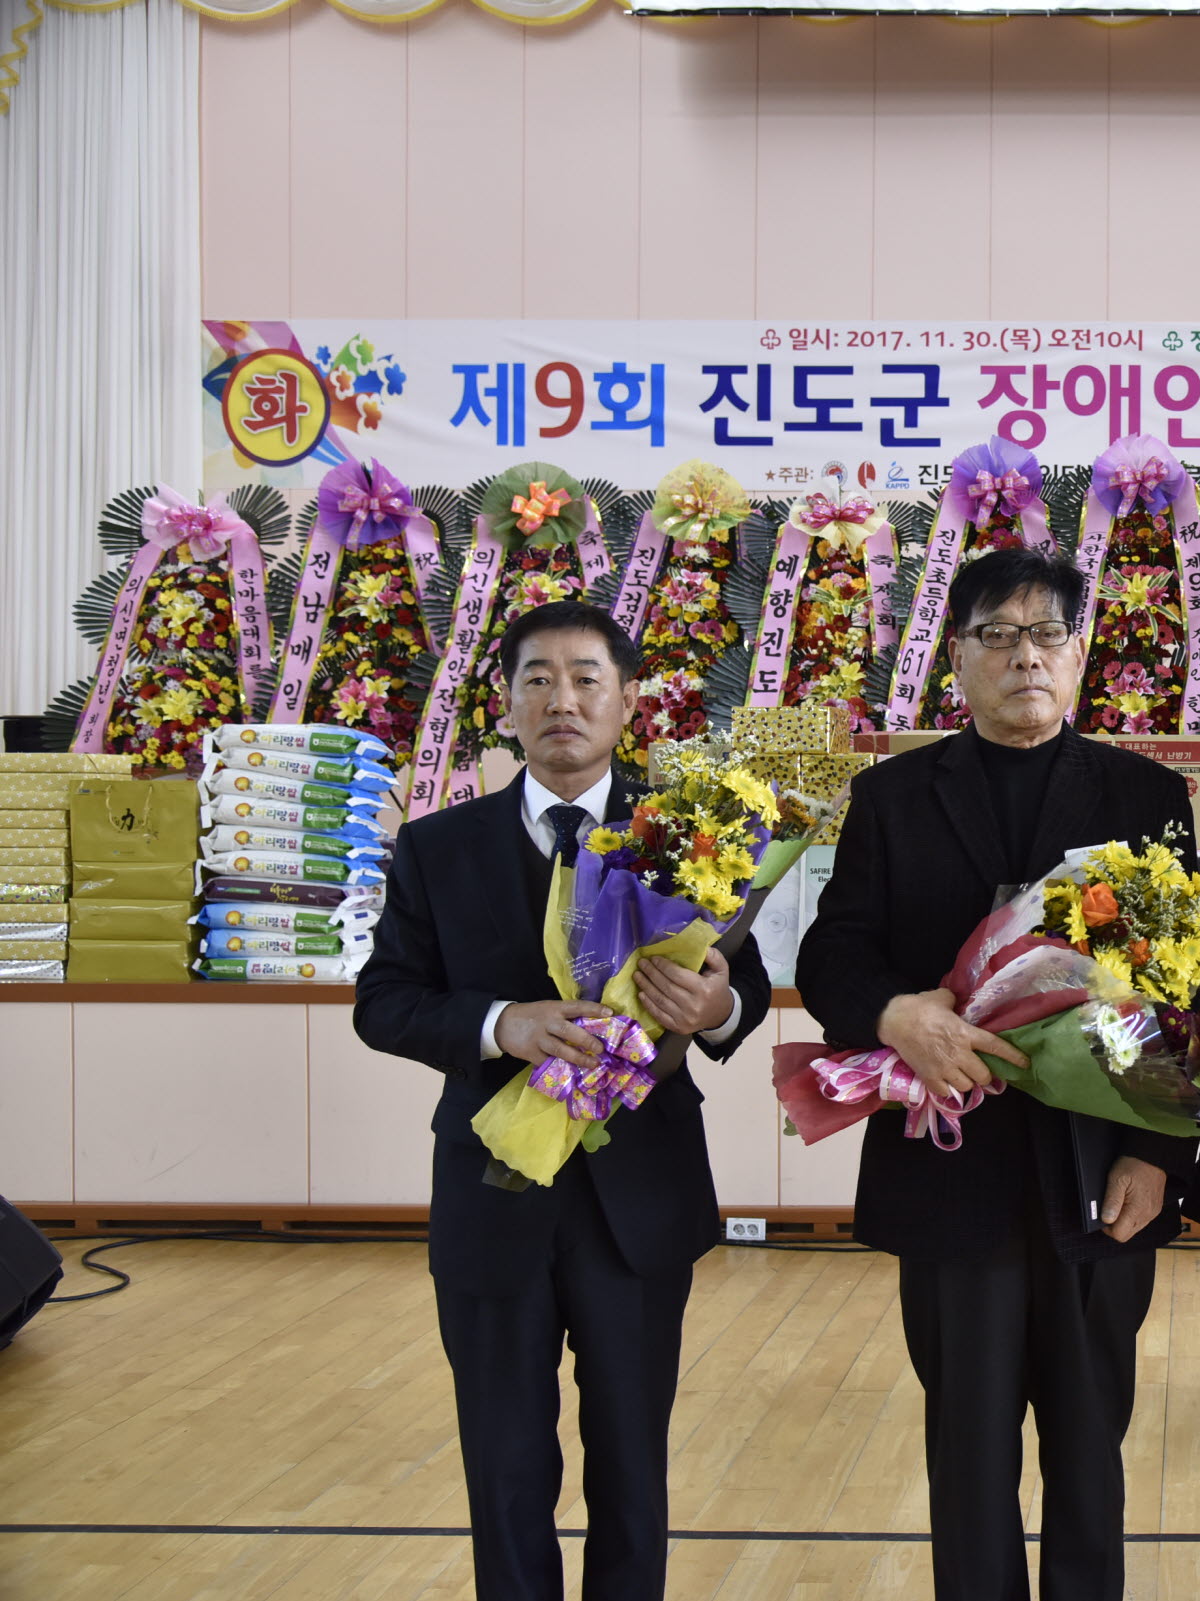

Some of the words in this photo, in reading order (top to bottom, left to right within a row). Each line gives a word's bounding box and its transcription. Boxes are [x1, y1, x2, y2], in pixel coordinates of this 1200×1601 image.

[789, 328, 839, 350] 일시:
[847, 331, 911, 350] 2017.
[919, 331, 954, 347] 11.
[1049, 328, 1143, 352] 오전10시
[241, 371, 309, 445] 화
[449, 361, 666, 448] 제9회
[698, 363, 950, 448] 진도군
[778, 466, 814, 483] 주관:
[908, 528, 957, 644] 진도초등학교
[283, 550, 332, 712] 전남매일
[751, 554, 801, 696] 예향진도
[1167, 751, 1192, 760] 난방기
[809, 867, 831, 875] SAFIRE
